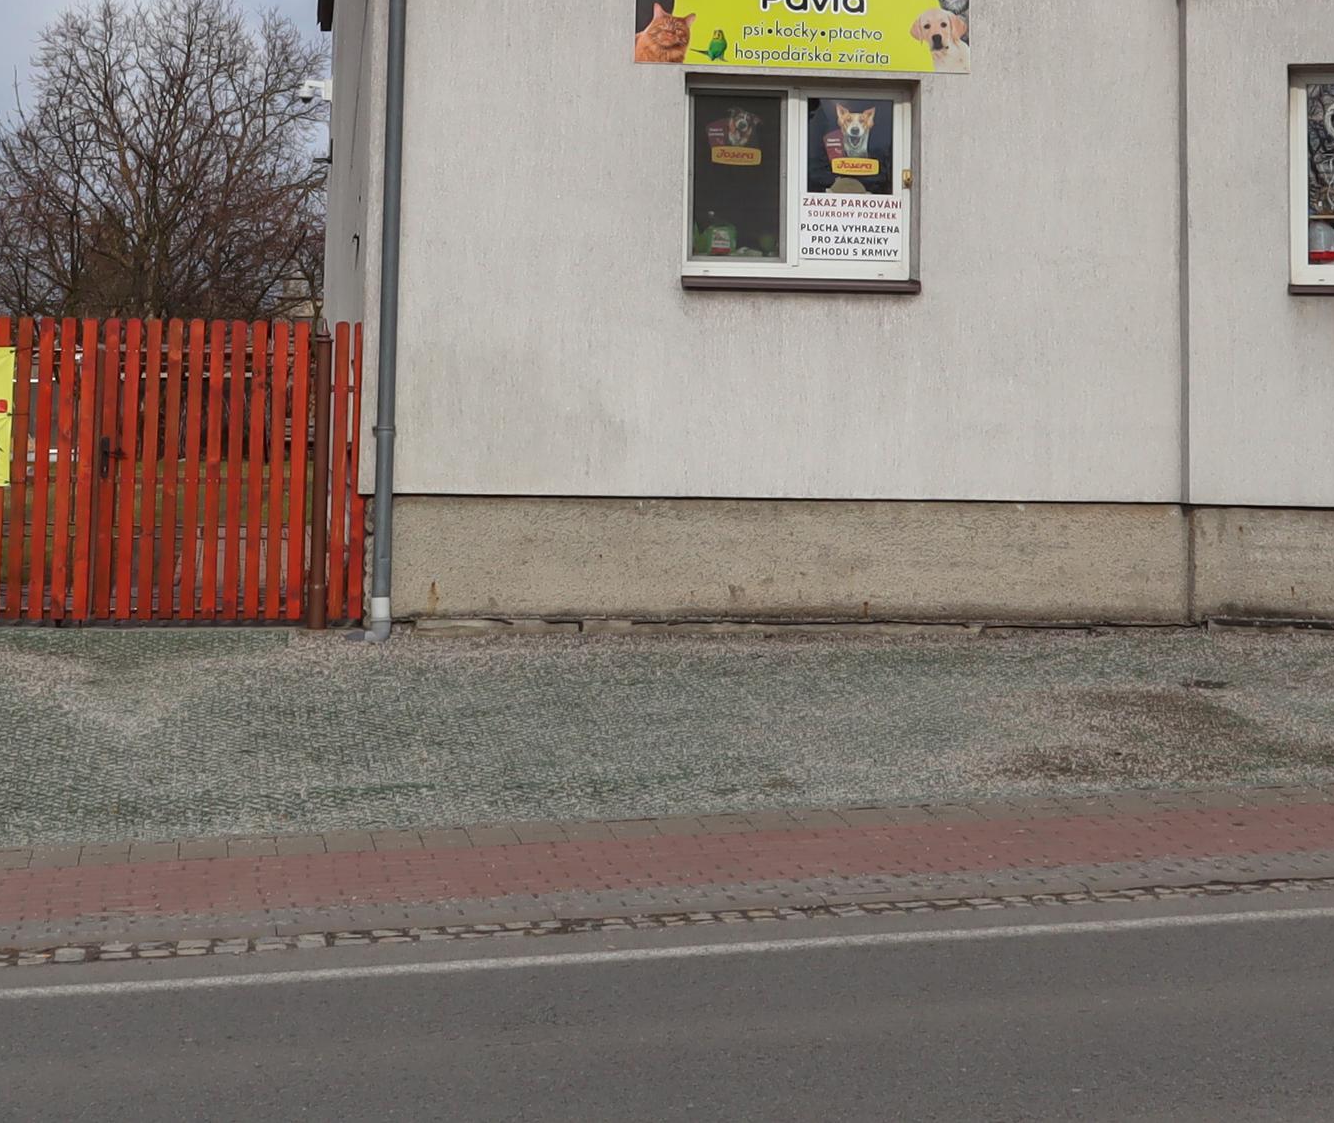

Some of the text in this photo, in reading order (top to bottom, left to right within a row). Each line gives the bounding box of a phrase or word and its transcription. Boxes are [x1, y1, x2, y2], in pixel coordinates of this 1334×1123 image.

[743, 20, 883, 43] psi kočky ptactvo
[734, 42, 889, 65] hospodářská zvířata
[800, 223, 900, 234] PLOCHA VYHRAZENA
[811, 235, 831, 244] PRO
[801, 247, 899, 257] OBCHODU S KRMIVY
